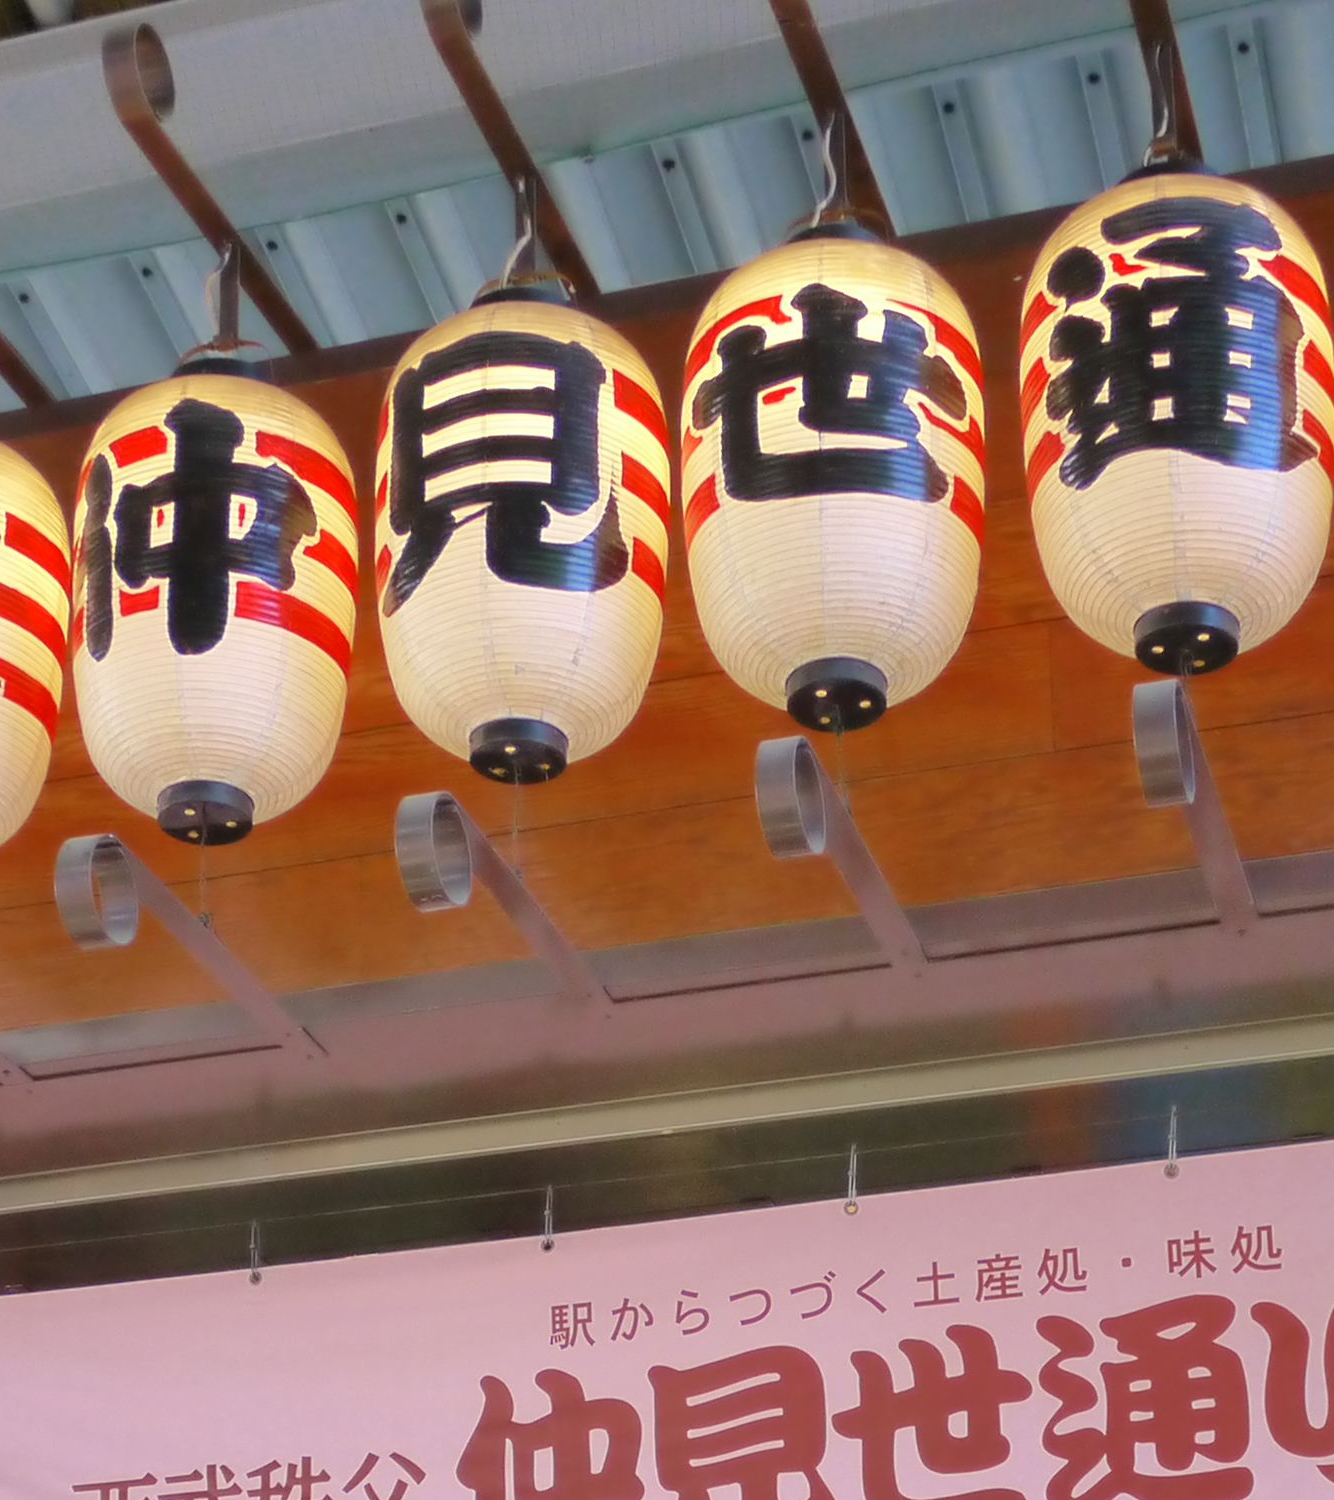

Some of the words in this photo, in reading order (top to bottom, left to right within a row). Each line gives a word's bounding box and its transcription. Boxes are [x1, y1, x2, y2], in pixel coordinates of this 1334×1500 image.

[548, 1224, 1282, 1350] 駅からつづく土産処・味処
